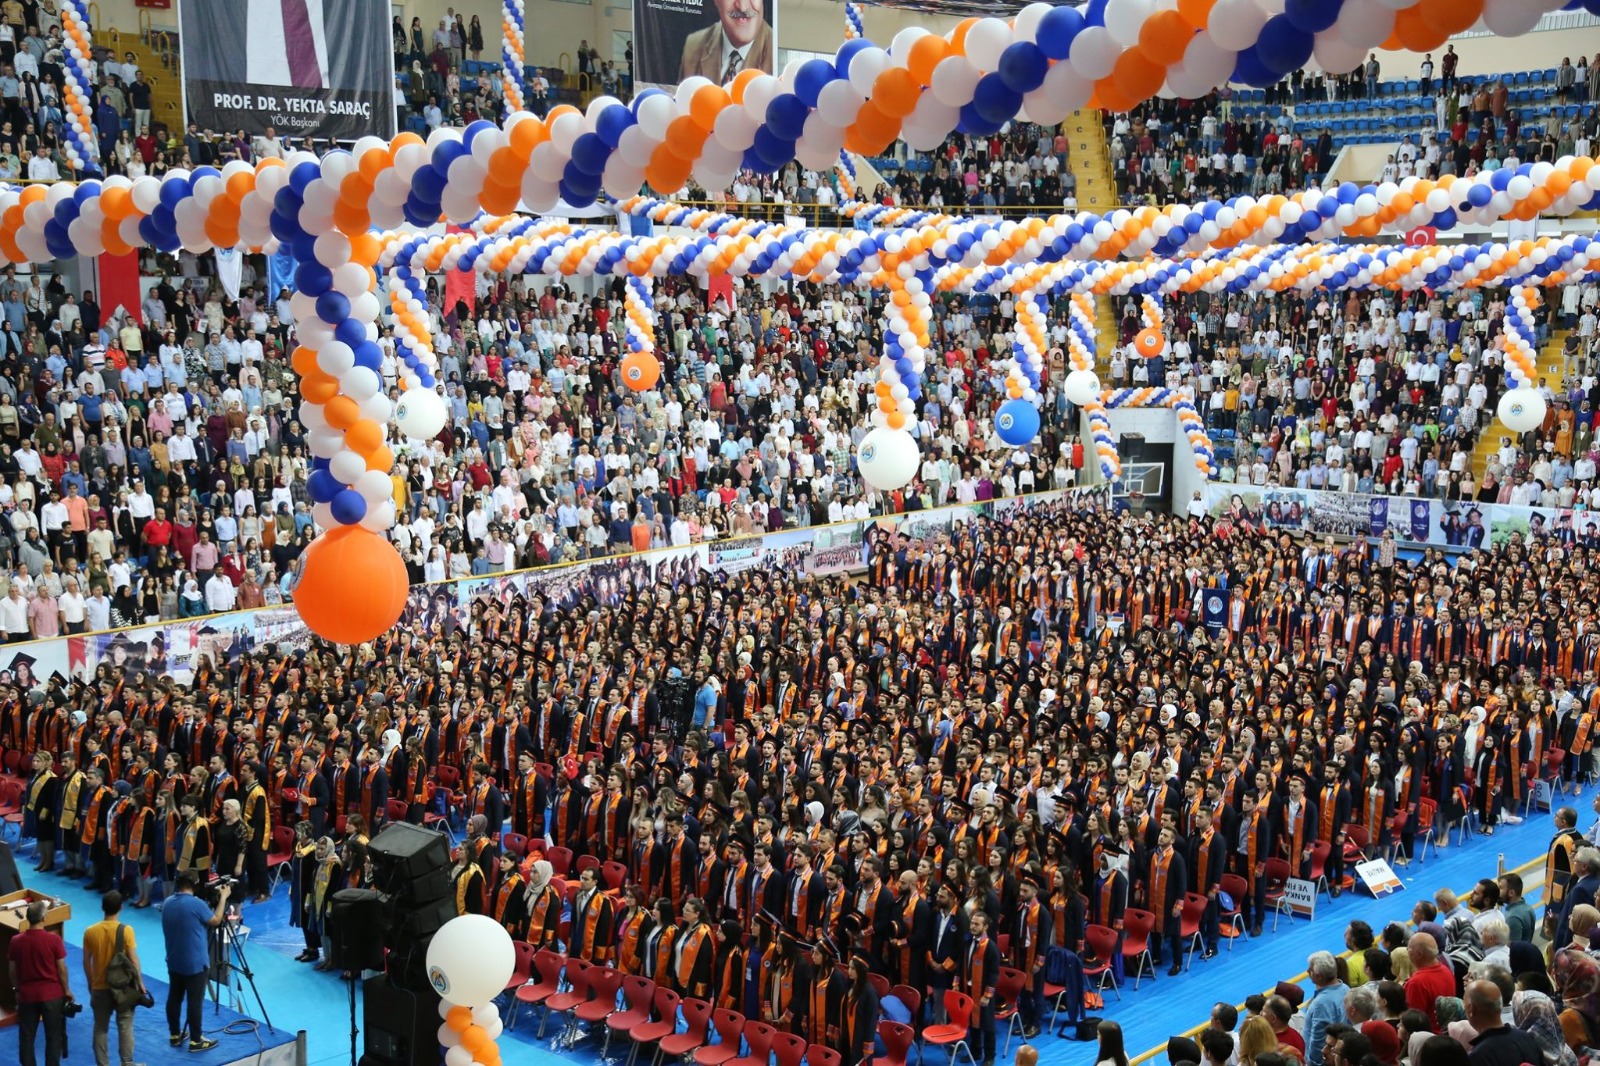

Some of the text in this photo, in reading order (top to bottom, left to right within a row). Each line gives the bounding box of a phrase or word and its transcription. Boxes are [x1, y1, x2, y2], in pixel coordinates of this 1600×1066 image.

[213, 93, 371, 119] PROF. DR. YEKTA SARAÇ
[270, 113, 320, 128] YÖK Başkanı
[1298, 884, 1308, 892] VE
[1285, 890, 1311, 902] BANKA
